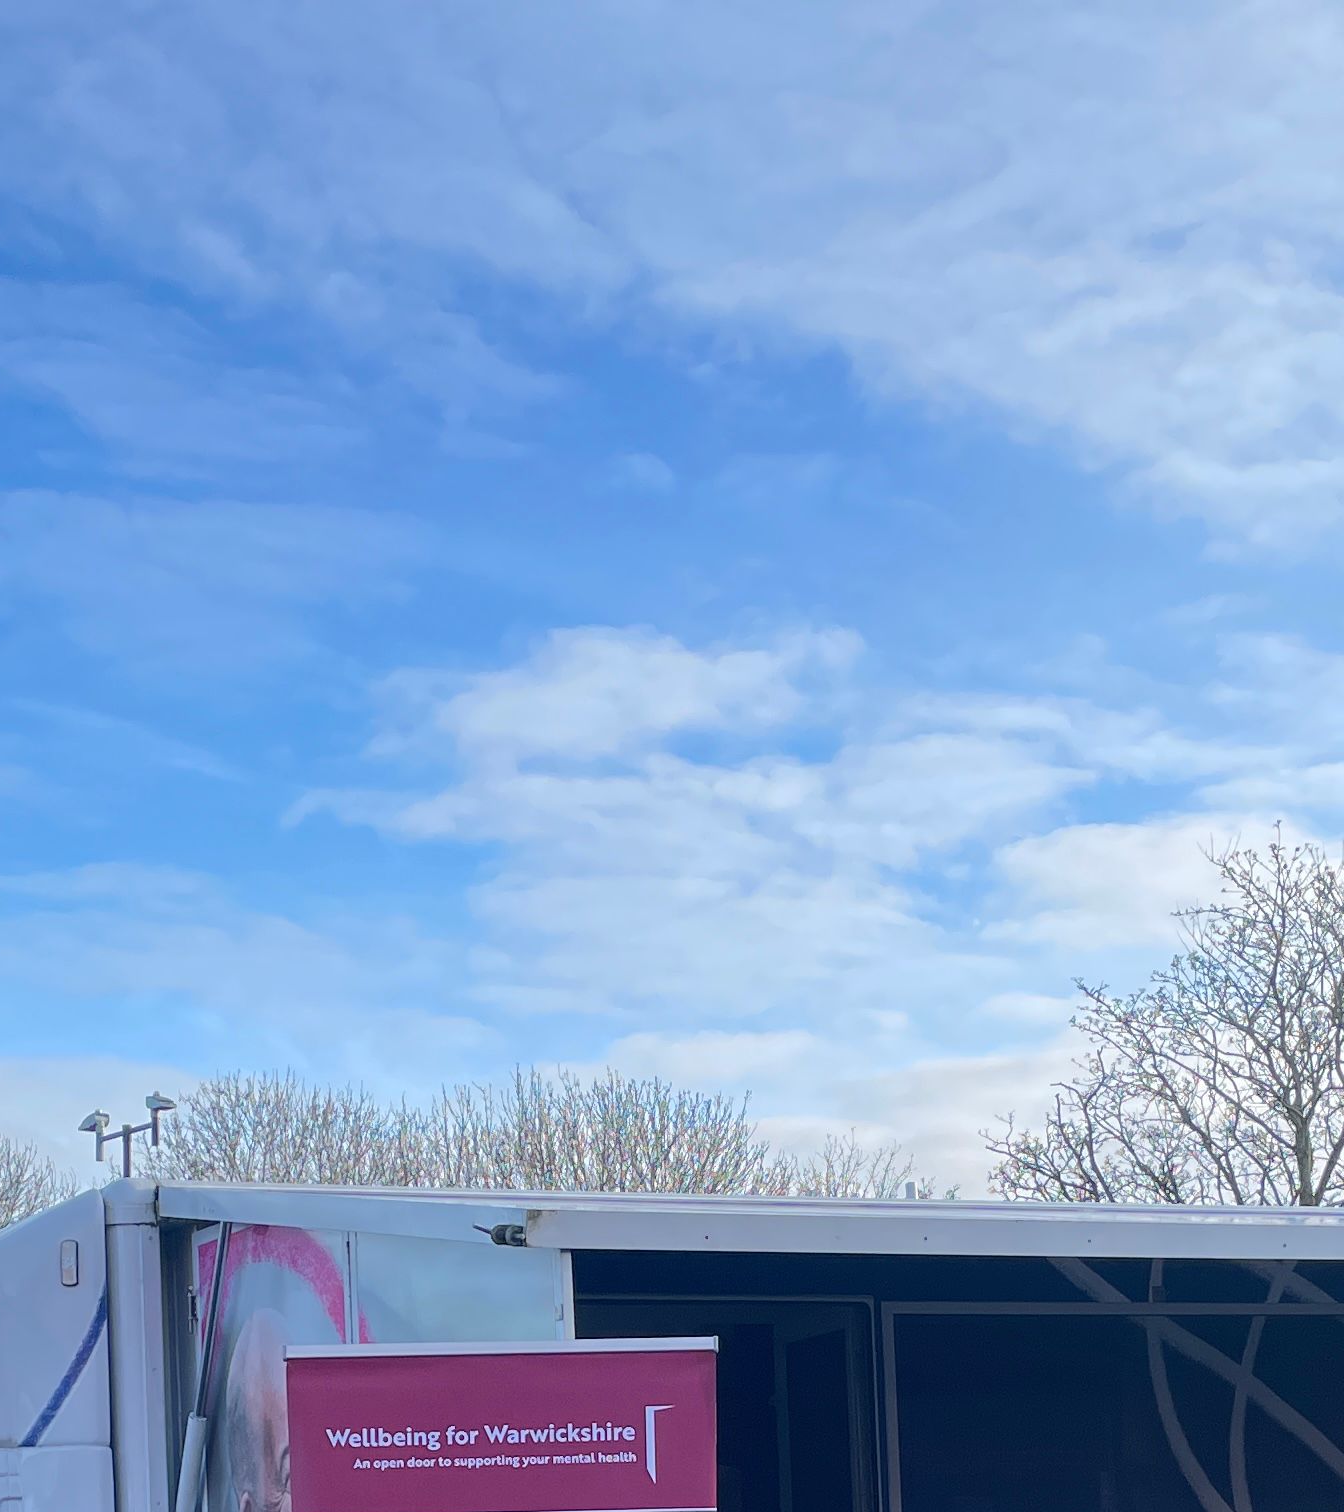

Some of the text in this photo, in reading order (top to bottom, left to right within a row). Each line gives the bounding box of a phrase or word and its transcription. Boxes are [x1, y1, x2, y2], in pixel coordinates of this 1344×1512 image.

[325, 1421, 636, 1451] Wellbeing for Warwickshire
[353, 1451, 637, 1472] An open door to supporting your mental health
